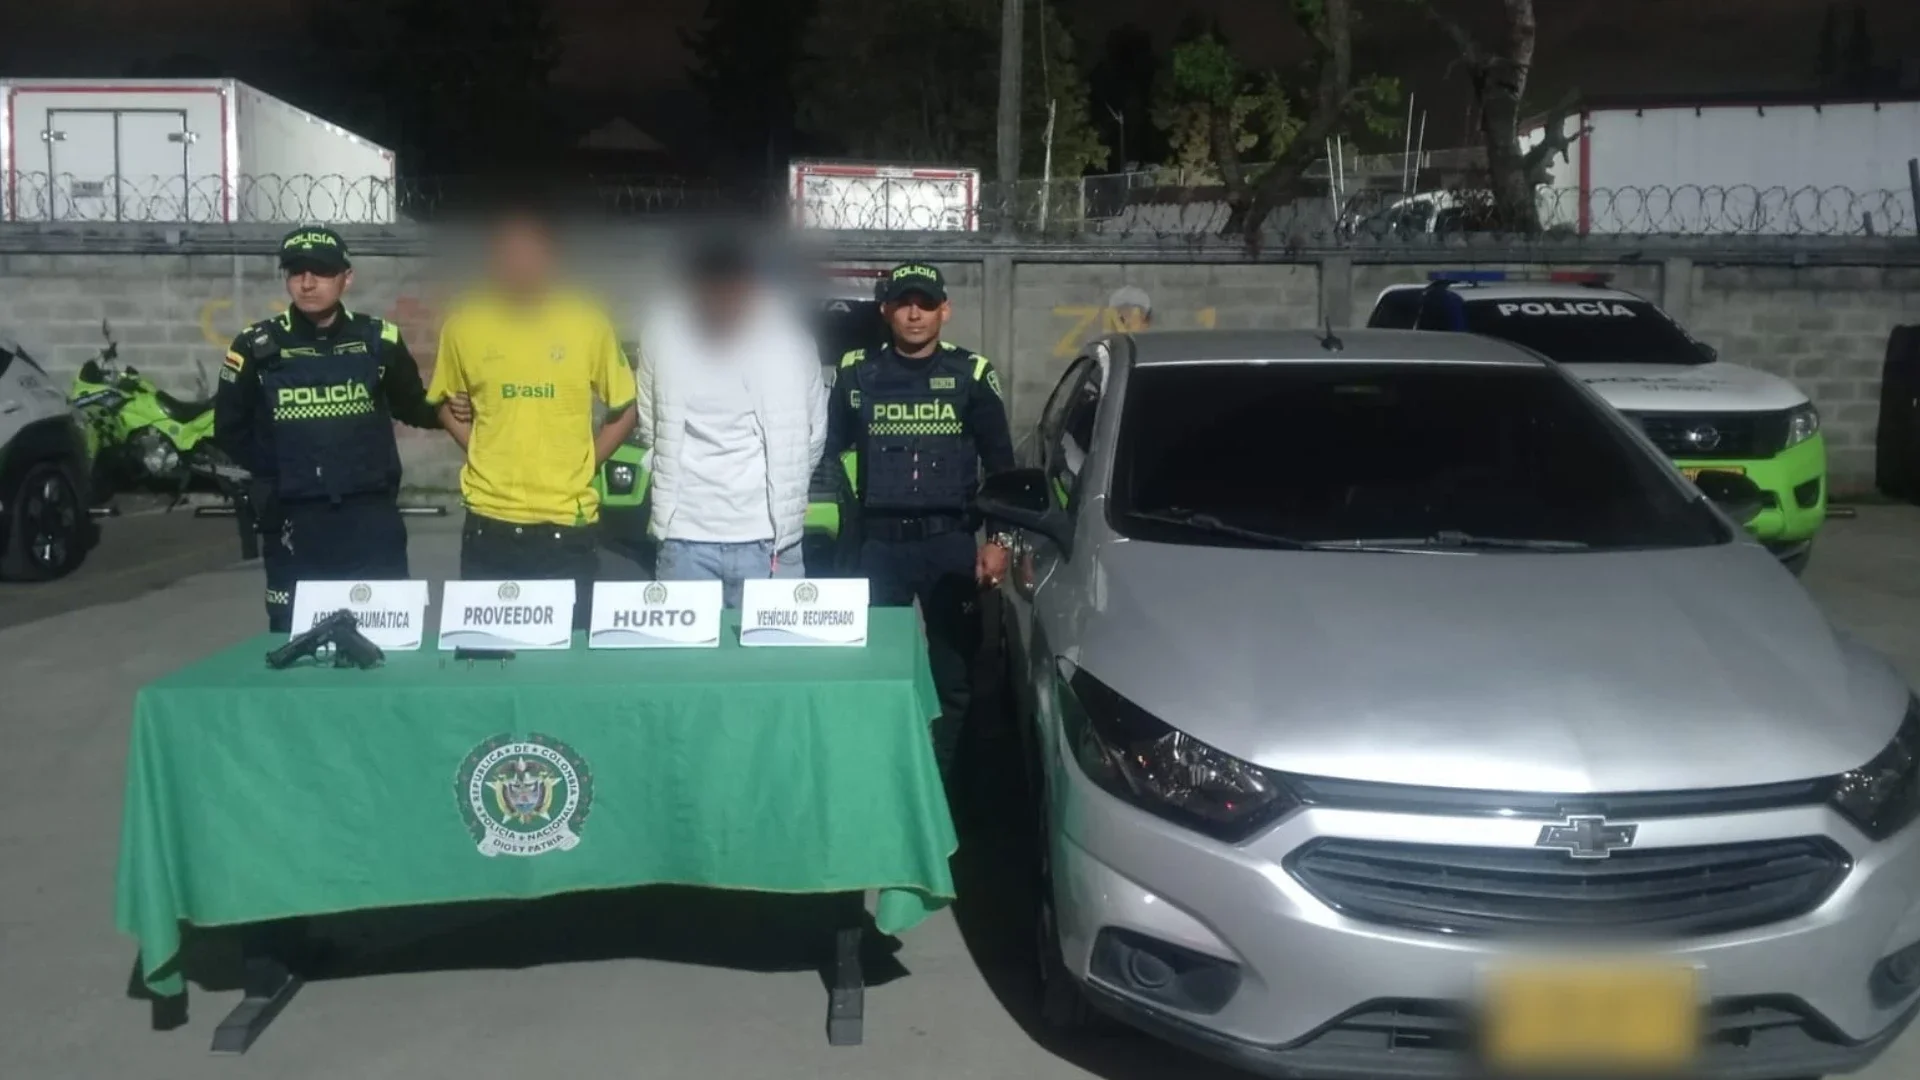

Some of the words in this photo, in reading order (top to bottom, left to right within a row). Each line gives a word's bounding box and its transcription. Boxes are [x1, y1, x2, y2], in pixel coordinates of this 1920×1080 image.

[1498, 301, 1636, 317] POLICÍA
[277, 378, 370, 405] POLICÍA
[873, 399, 957, 420] POLICÍA
[463, 606, 554, 626] PROVEEDOR
[613, 609, 697, 628] HURTO
[757, 608, 798, 626] VEHÍCULO
[802, 609, 855, 627] RECUPERADO
[514, 745, 529, 753] DE
[541, 749, 577, 796] COLOMBIA
[528, 806, 574, 842] NACIONAL
